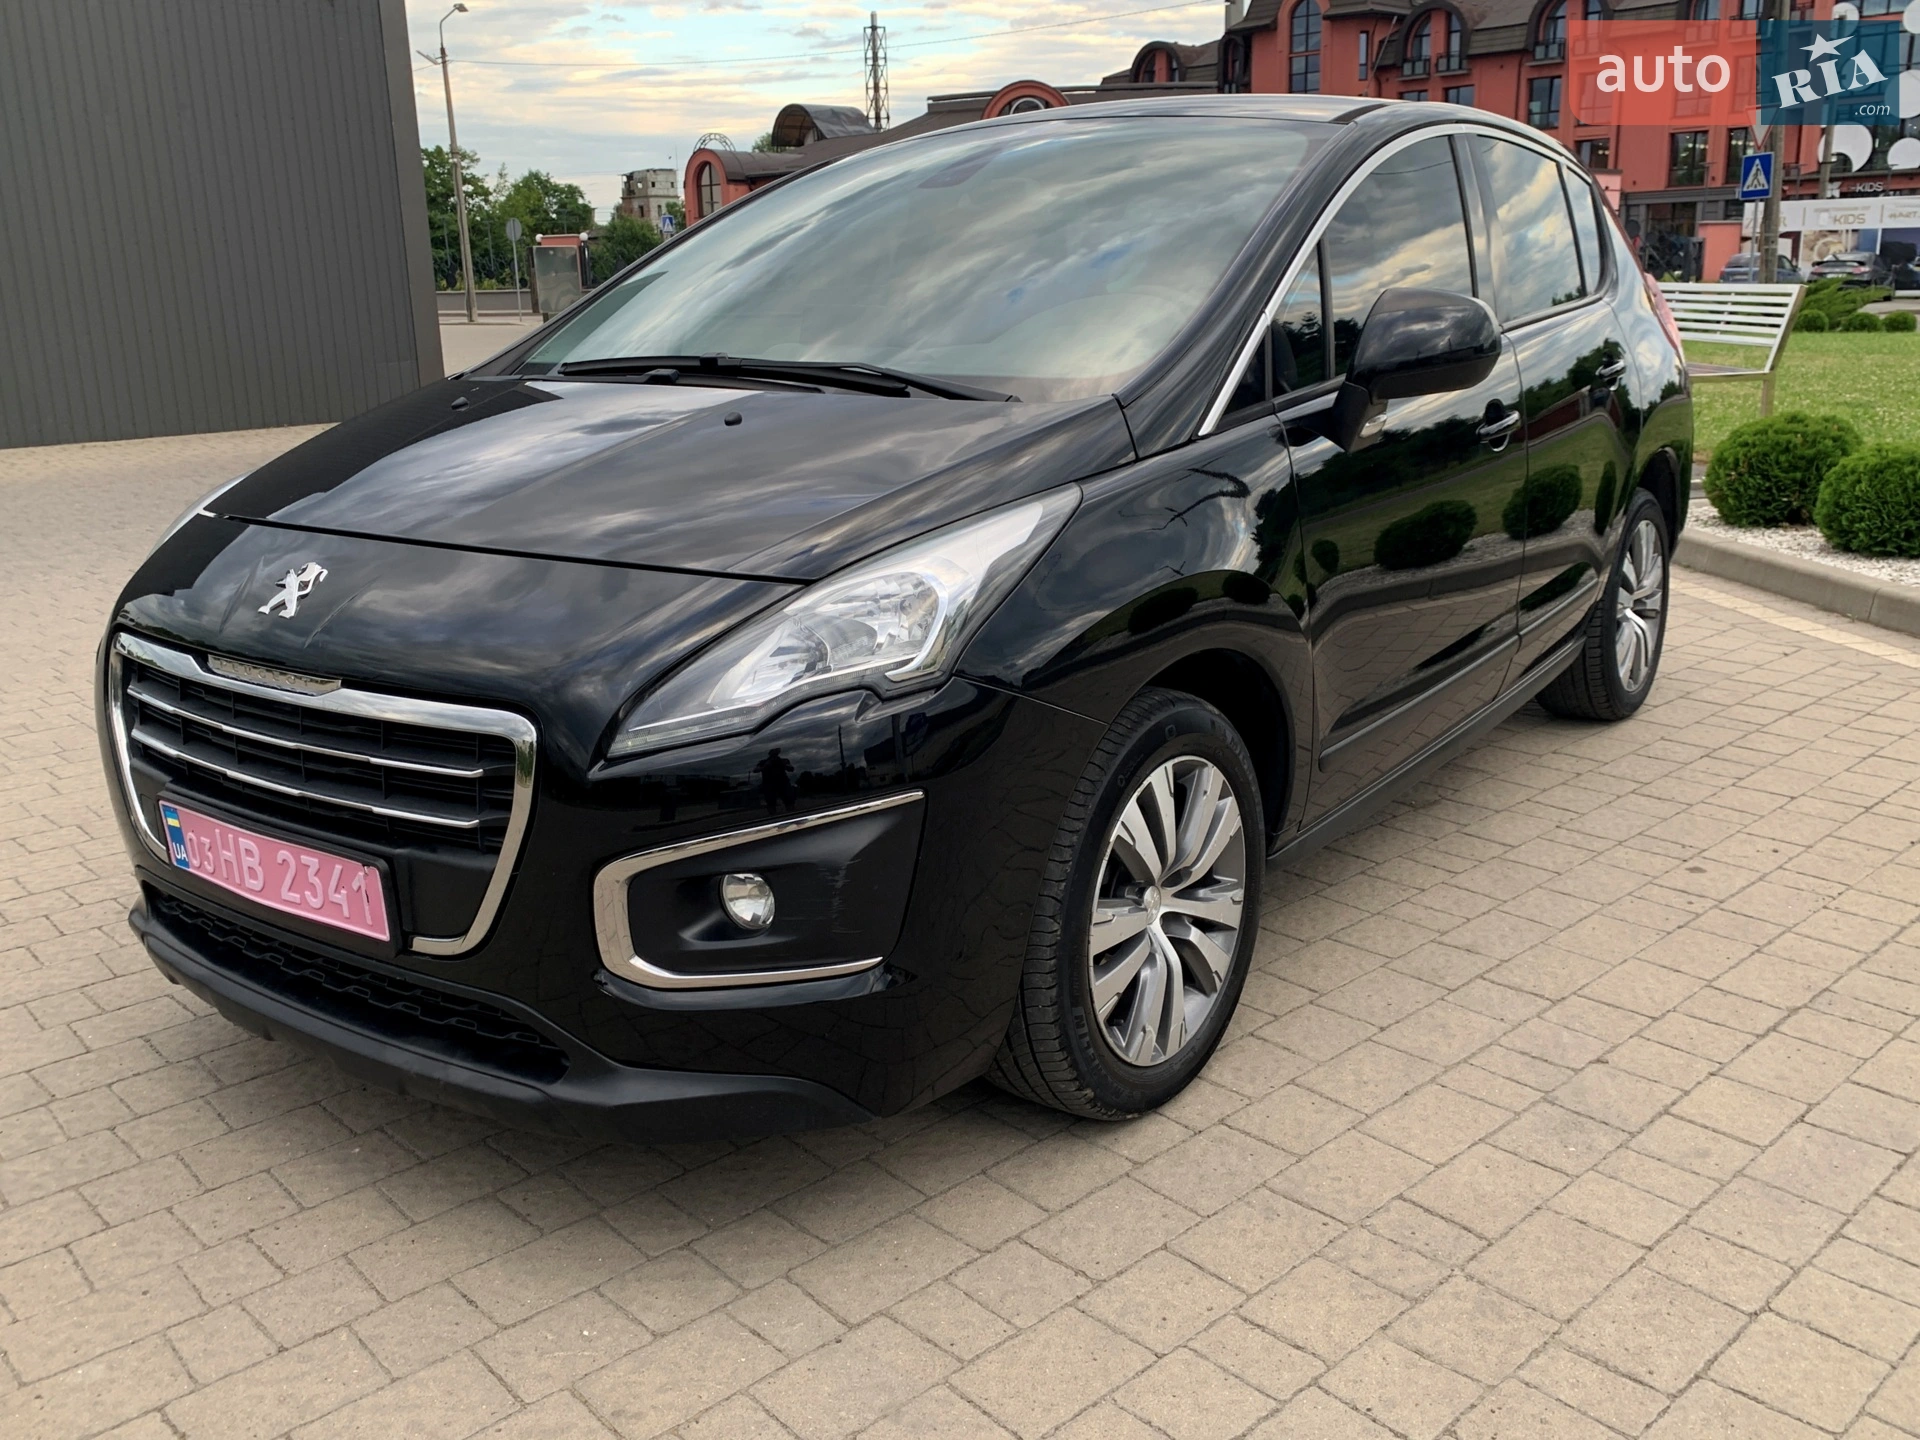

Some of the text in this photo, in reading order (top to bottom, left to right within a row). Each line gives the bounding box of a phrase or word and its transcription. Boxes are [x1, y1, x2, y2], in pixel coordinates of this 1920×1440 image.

[1833, 213, 1866, 225] KIDS
[220, 659, 310, 687] PEUGEOT
[173, 842, 188, 862] UA
[276, 849, 374, 926] 2341
